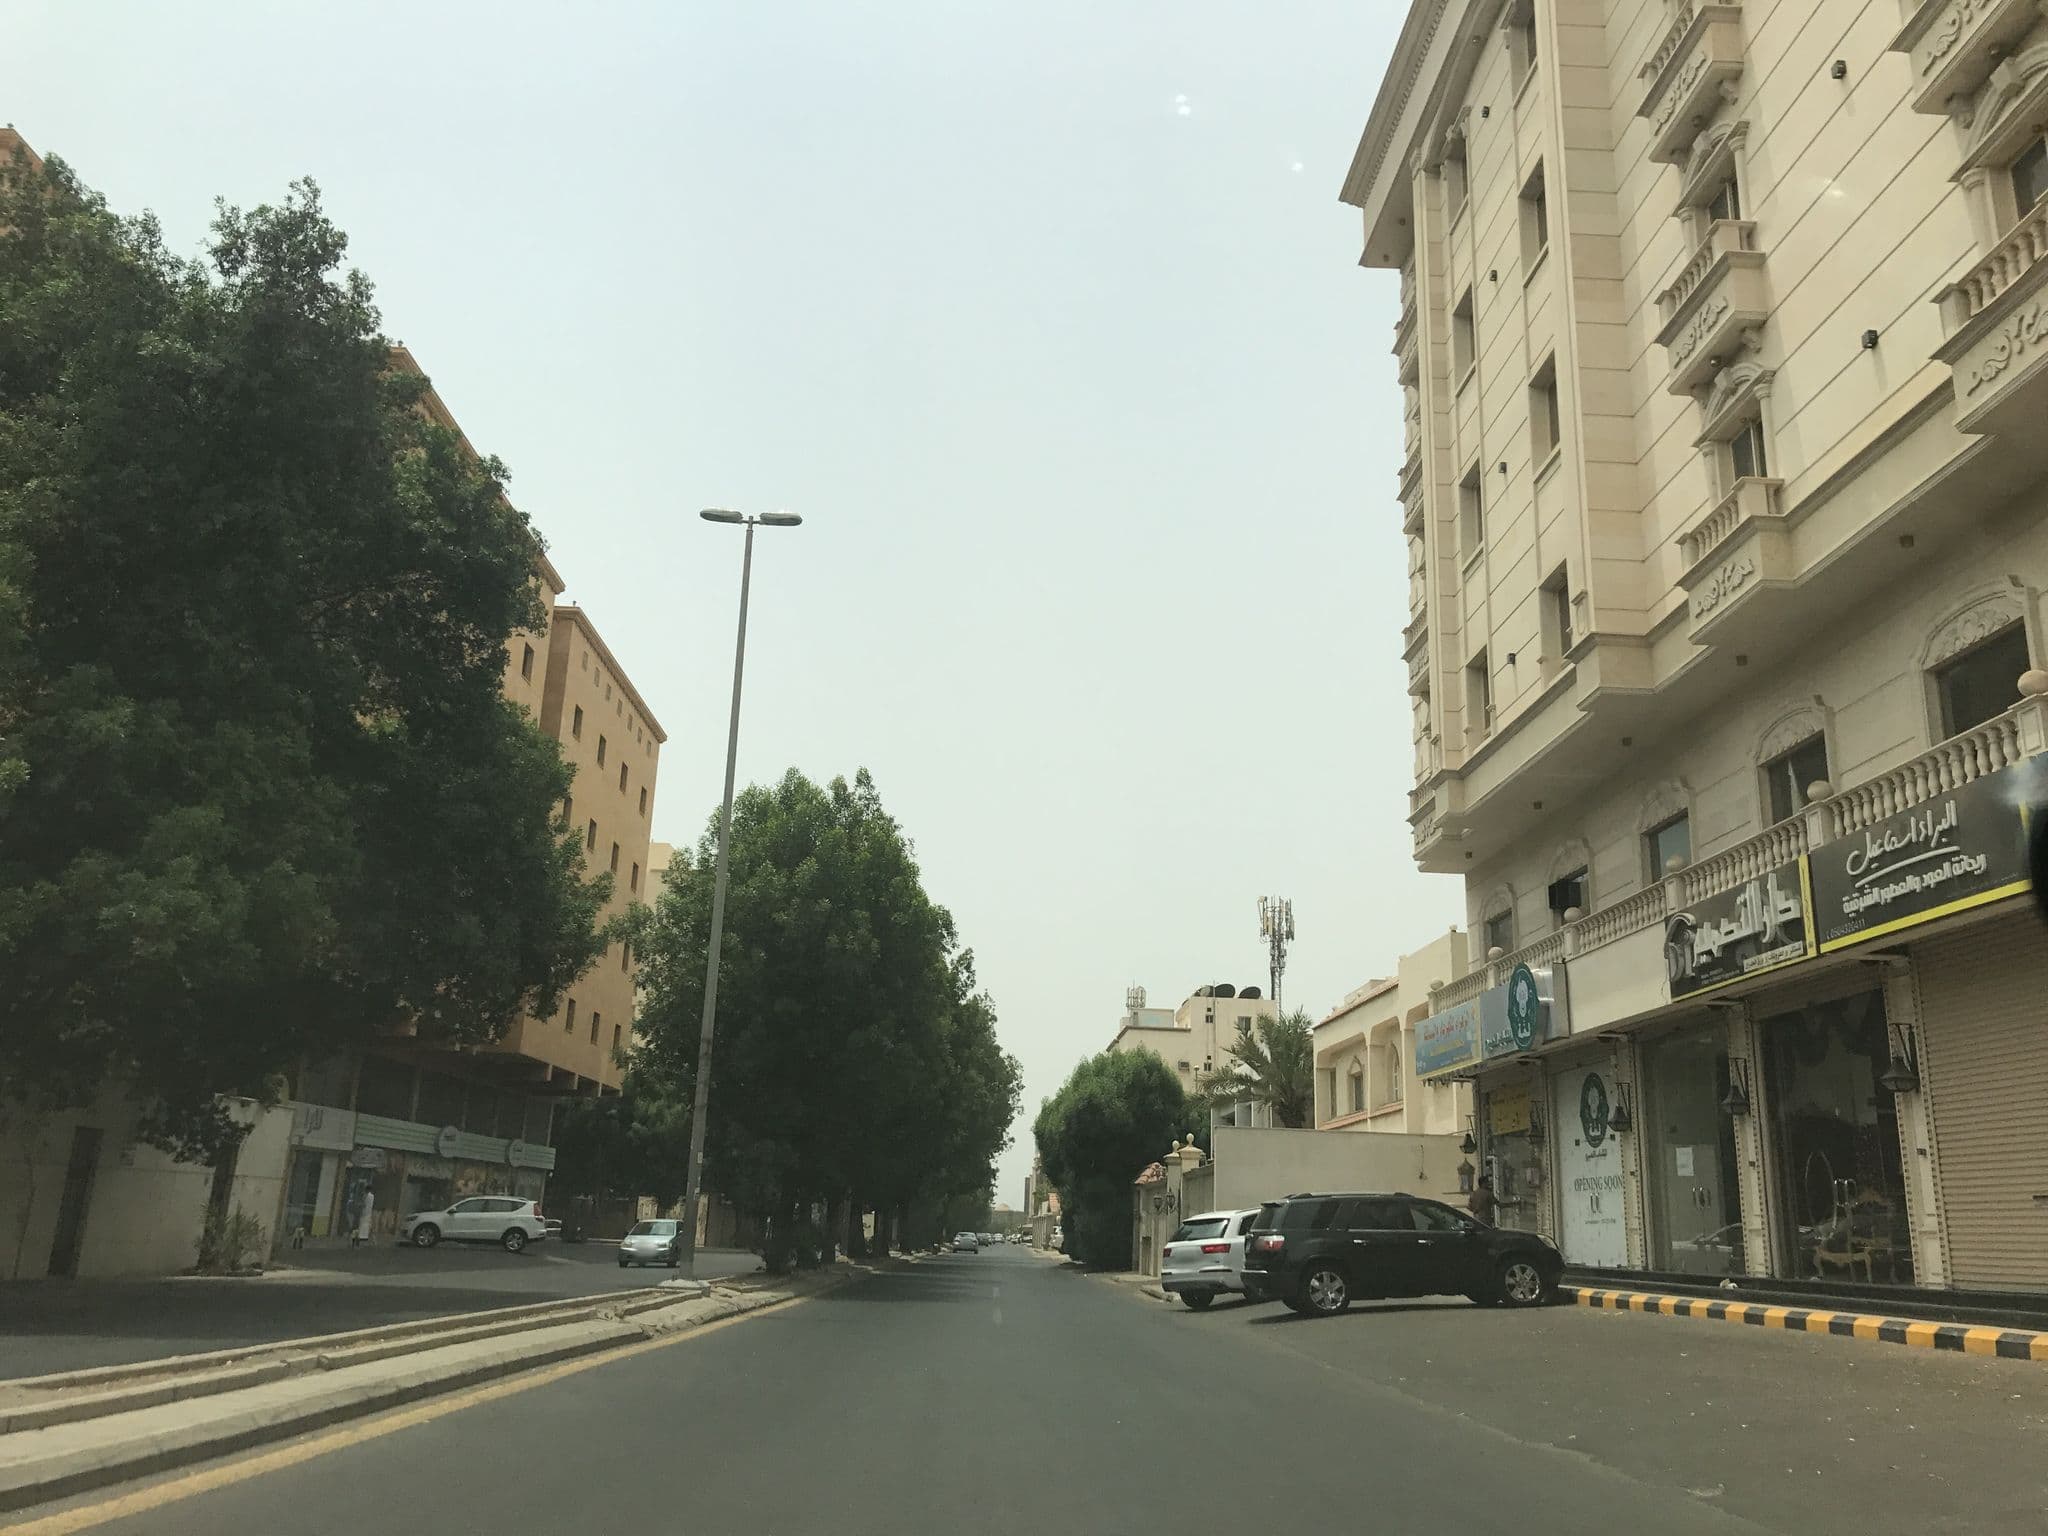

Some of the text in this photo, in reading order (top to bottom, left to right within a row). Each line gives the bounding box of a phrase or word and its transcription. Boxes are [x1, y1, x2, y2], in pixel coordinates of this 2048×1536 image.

[1921, 859, 1952, 889] العود
[1951, 853, 1988, 876] ريحانة
[1842, 884, 1881, 918] الشرقية
[1573, 1174, 1624, 1192] OPENING SOON
